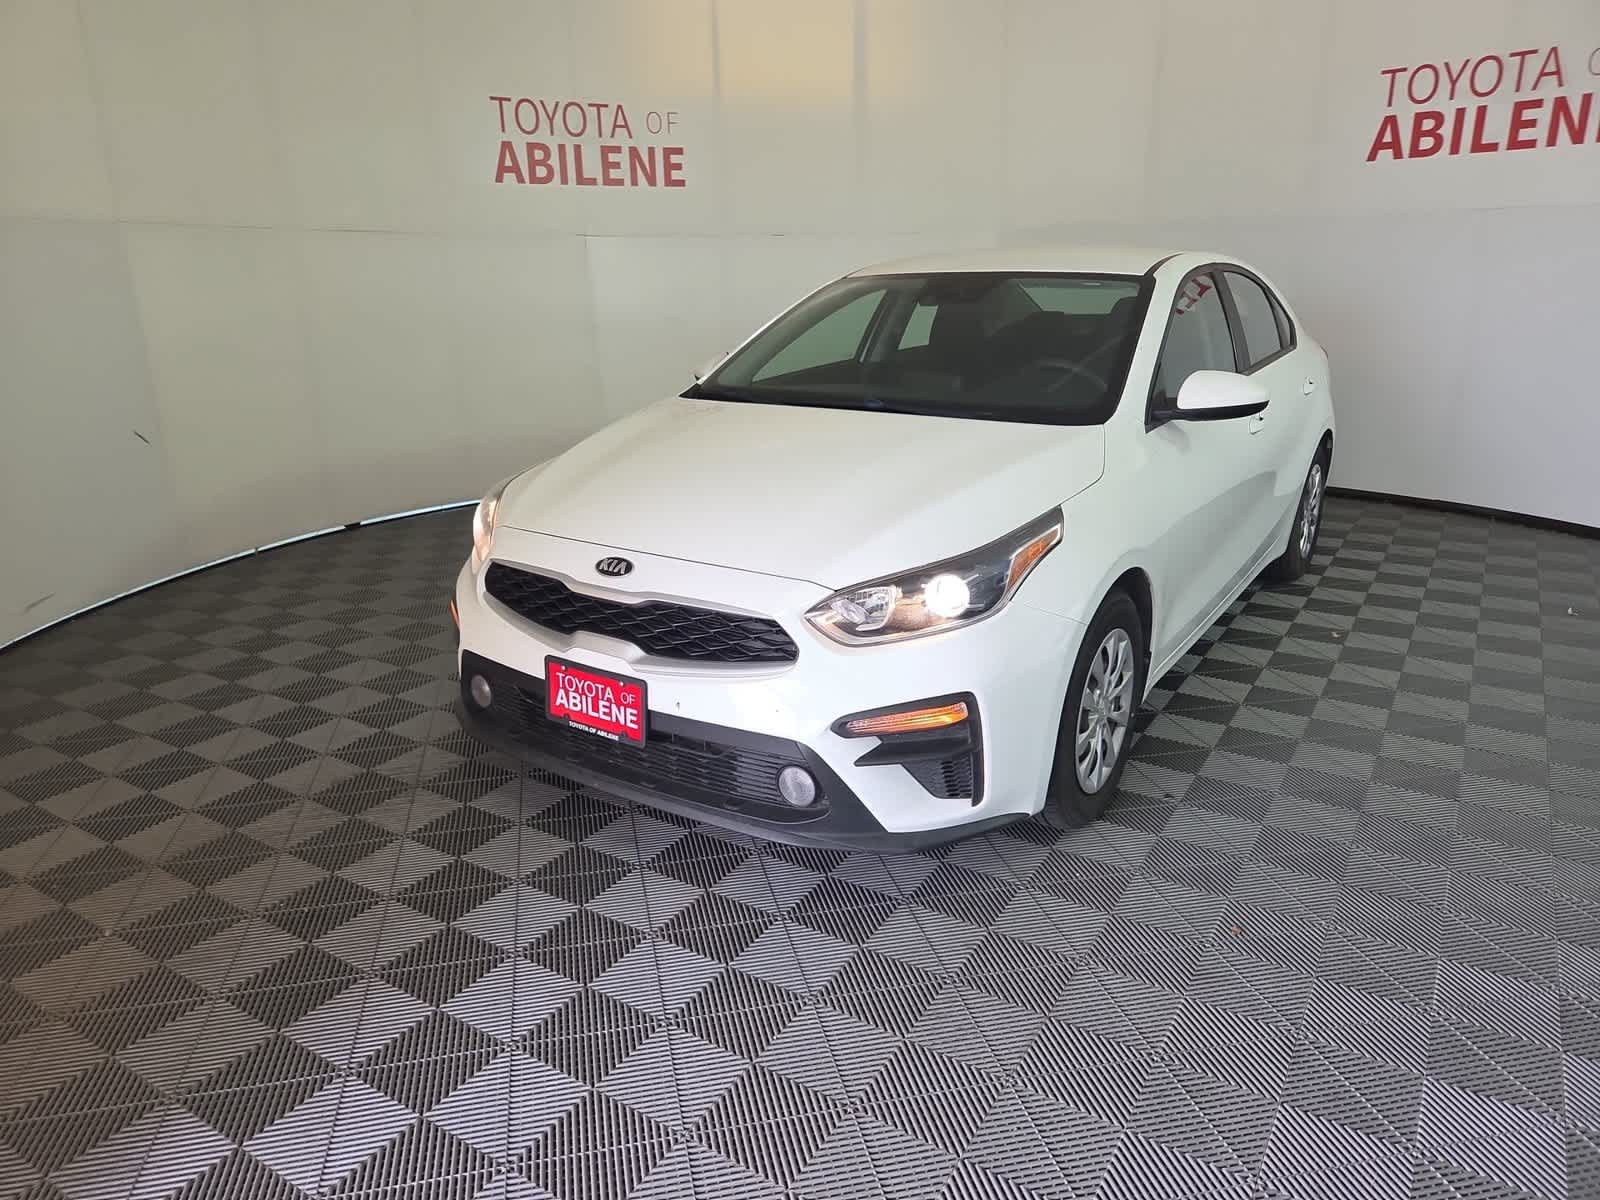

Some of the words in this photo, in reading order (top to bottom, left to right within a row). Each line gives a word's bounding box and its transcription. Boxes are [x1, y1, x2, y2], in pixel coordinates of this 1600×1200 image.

[1381, 46, 1565, 108] TOYOTA
[489, 96, 633, 139] TOYOTA
[646, 111, 679, 135] OF
[1366, 92, 1600, 162] ABILEN
[495, 140, 686, 188] ABILENE
[599, 558, 627, 575] KIA
[555, 688, 639, 730] ABILENE
[556, 672, 615, 703] TOYOTA
[620, 692, 636, 705] OF
